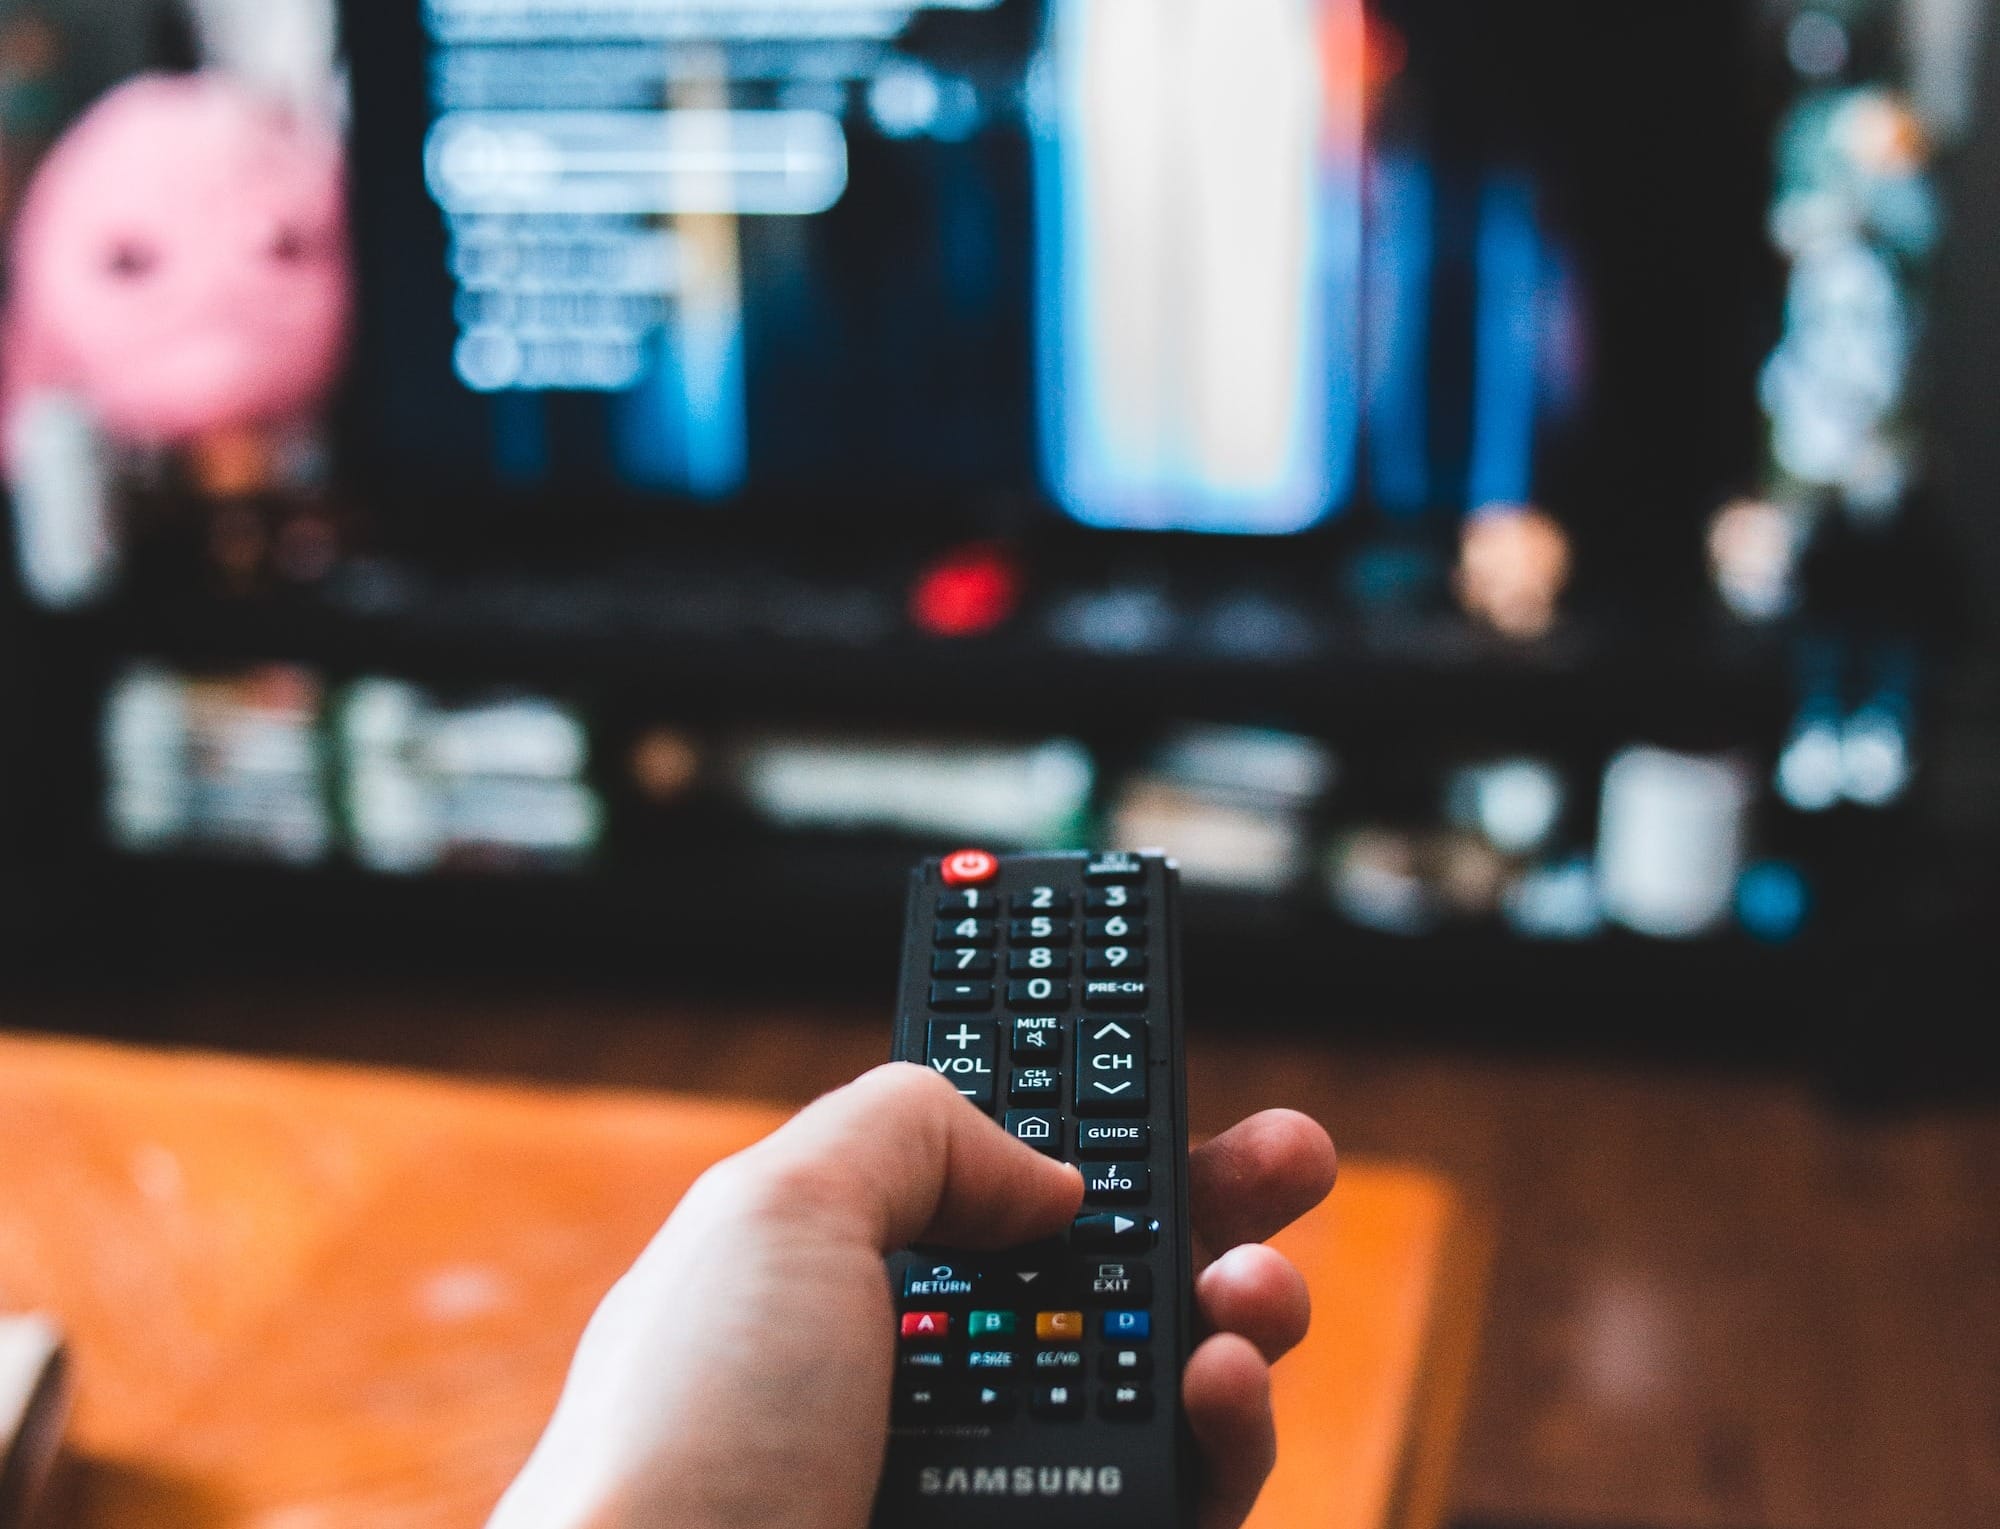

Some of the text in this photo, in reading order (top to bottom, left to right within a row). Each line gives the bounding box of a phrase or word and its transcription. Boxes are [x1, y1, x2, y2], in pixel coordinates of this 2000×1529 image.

[963, 889, 979, 907] 1
[1031, 887, 1053, 908] 2
[1105, 886, 1127, 907] 3
[955, 918, 978, 938] 4
[1030, 917, 1052, 937] 5
[1105, 915, 1128, 936] 6
[955, 948, 977, 969] 7
[1028, 947, 1052, 969] 8
[1105, 947, 1128, 968] 9
[1027, 978, 1052, 999] 0
[1088, 982, 1144, 993] PRE-CH
[1017, 1018, 1057, 1029] MUTE
[932, 1058, 991, 1073] VOL
[1093, 1054, 1133, 1070] CH
[1024, 1069, 1047, 1078] CH
[1018, 1077, 1053, 1088] LIST
[1088, 1127, 1139, 1139] GUIDE
[1092, 1178, 1133, 1190] INFO
[911, 1280, 972, 1294] RETURN
[1093, 1279, 1130, 1292] EXIT
[917, 1314, 935, 1330] A
[986, 1314, 1001, 1328] B
[1051, 1313, 1066, 1328] C
[1119, 1312, 1135, 1327] D
[969, 1351, 1014, 1366] P.SIZE
[919, 1466, 1122, 1496] SAMSUNG
